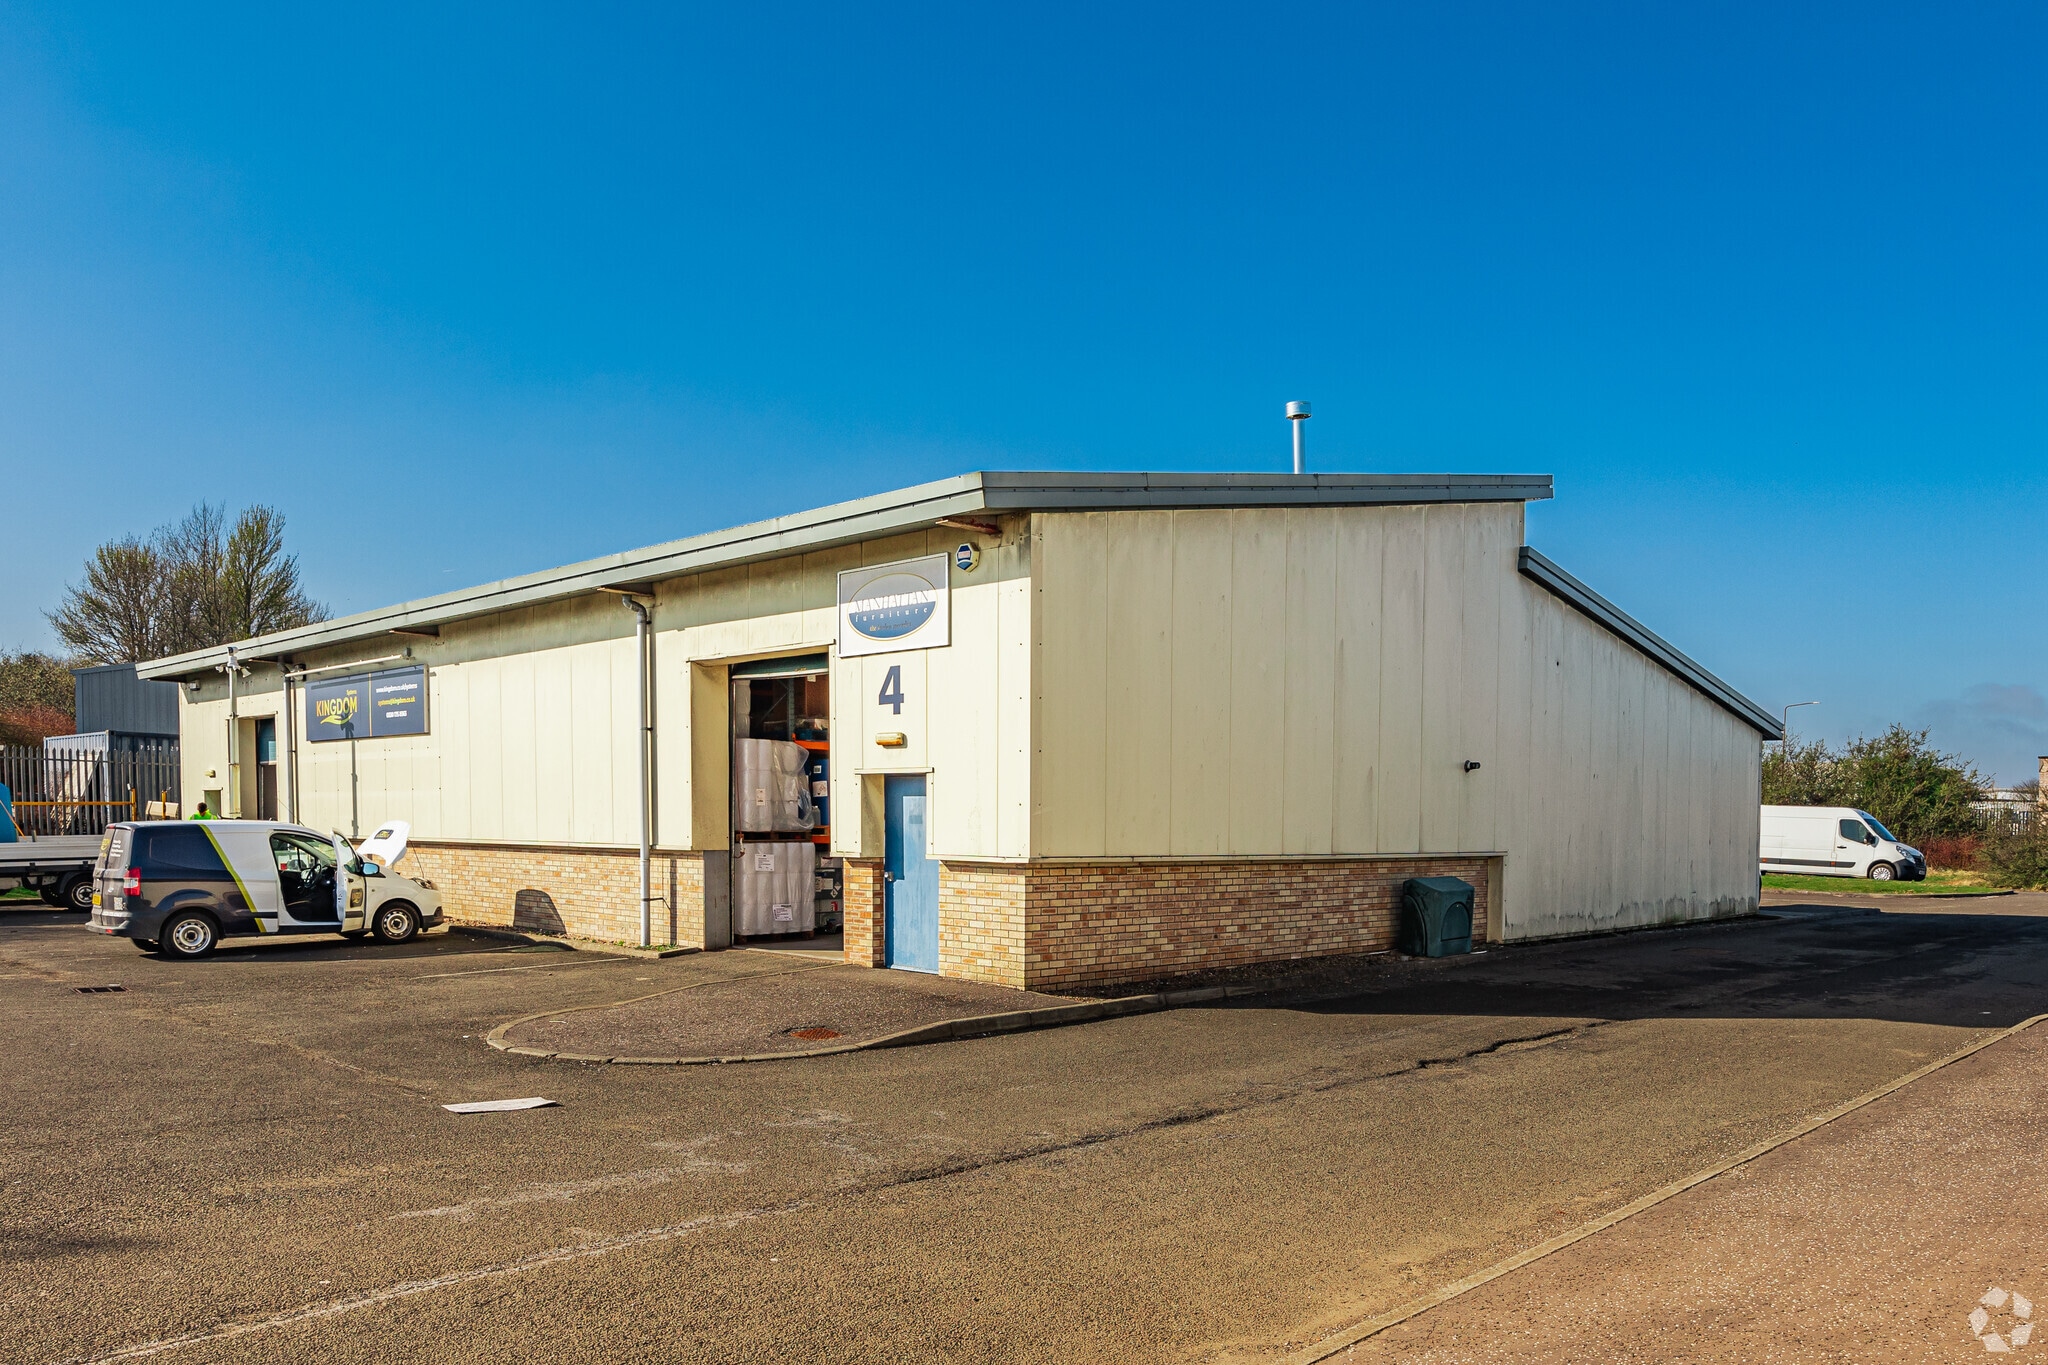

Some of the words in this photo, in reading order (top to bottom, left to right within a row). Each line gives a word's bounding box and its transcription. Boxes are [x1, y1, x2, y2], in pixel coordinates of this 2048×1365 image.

[855, 607, 928, 622] furniture
[878, 665, 905, 715] 4
[316, 696, 358, 717] KINGDOM
